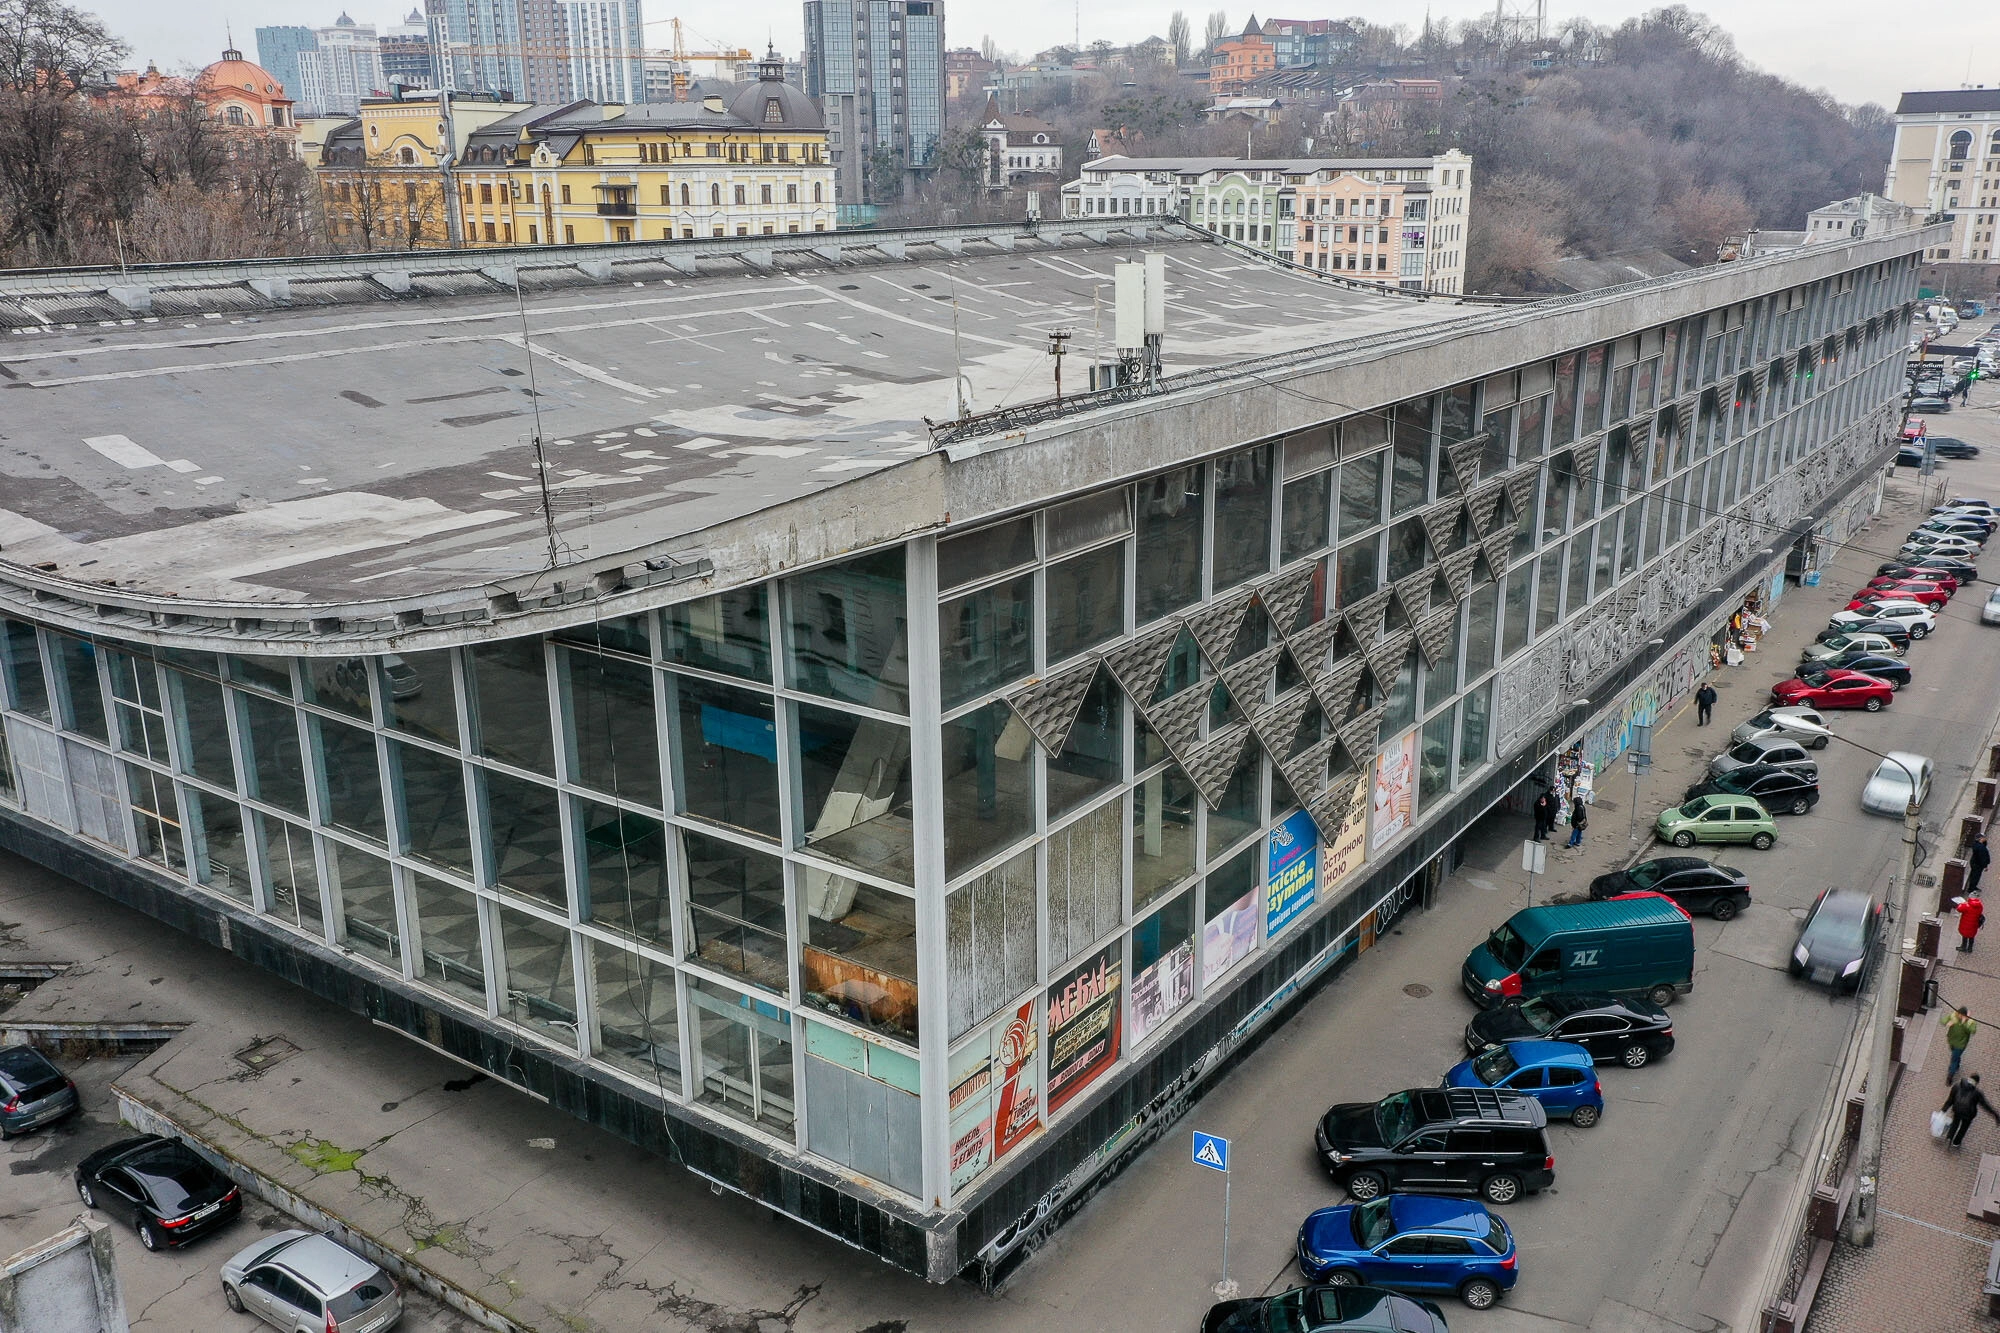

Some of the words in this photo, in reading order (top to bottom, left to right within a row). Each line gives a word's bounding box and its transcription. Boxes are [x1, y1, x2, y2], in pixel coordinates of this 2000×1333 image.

[1323, 834, 1364, 872] ОСТУПНОЮ
[1323, 861, 1346, 888] ІНОЮ
[1570, 950, 1598, 967] AZ
